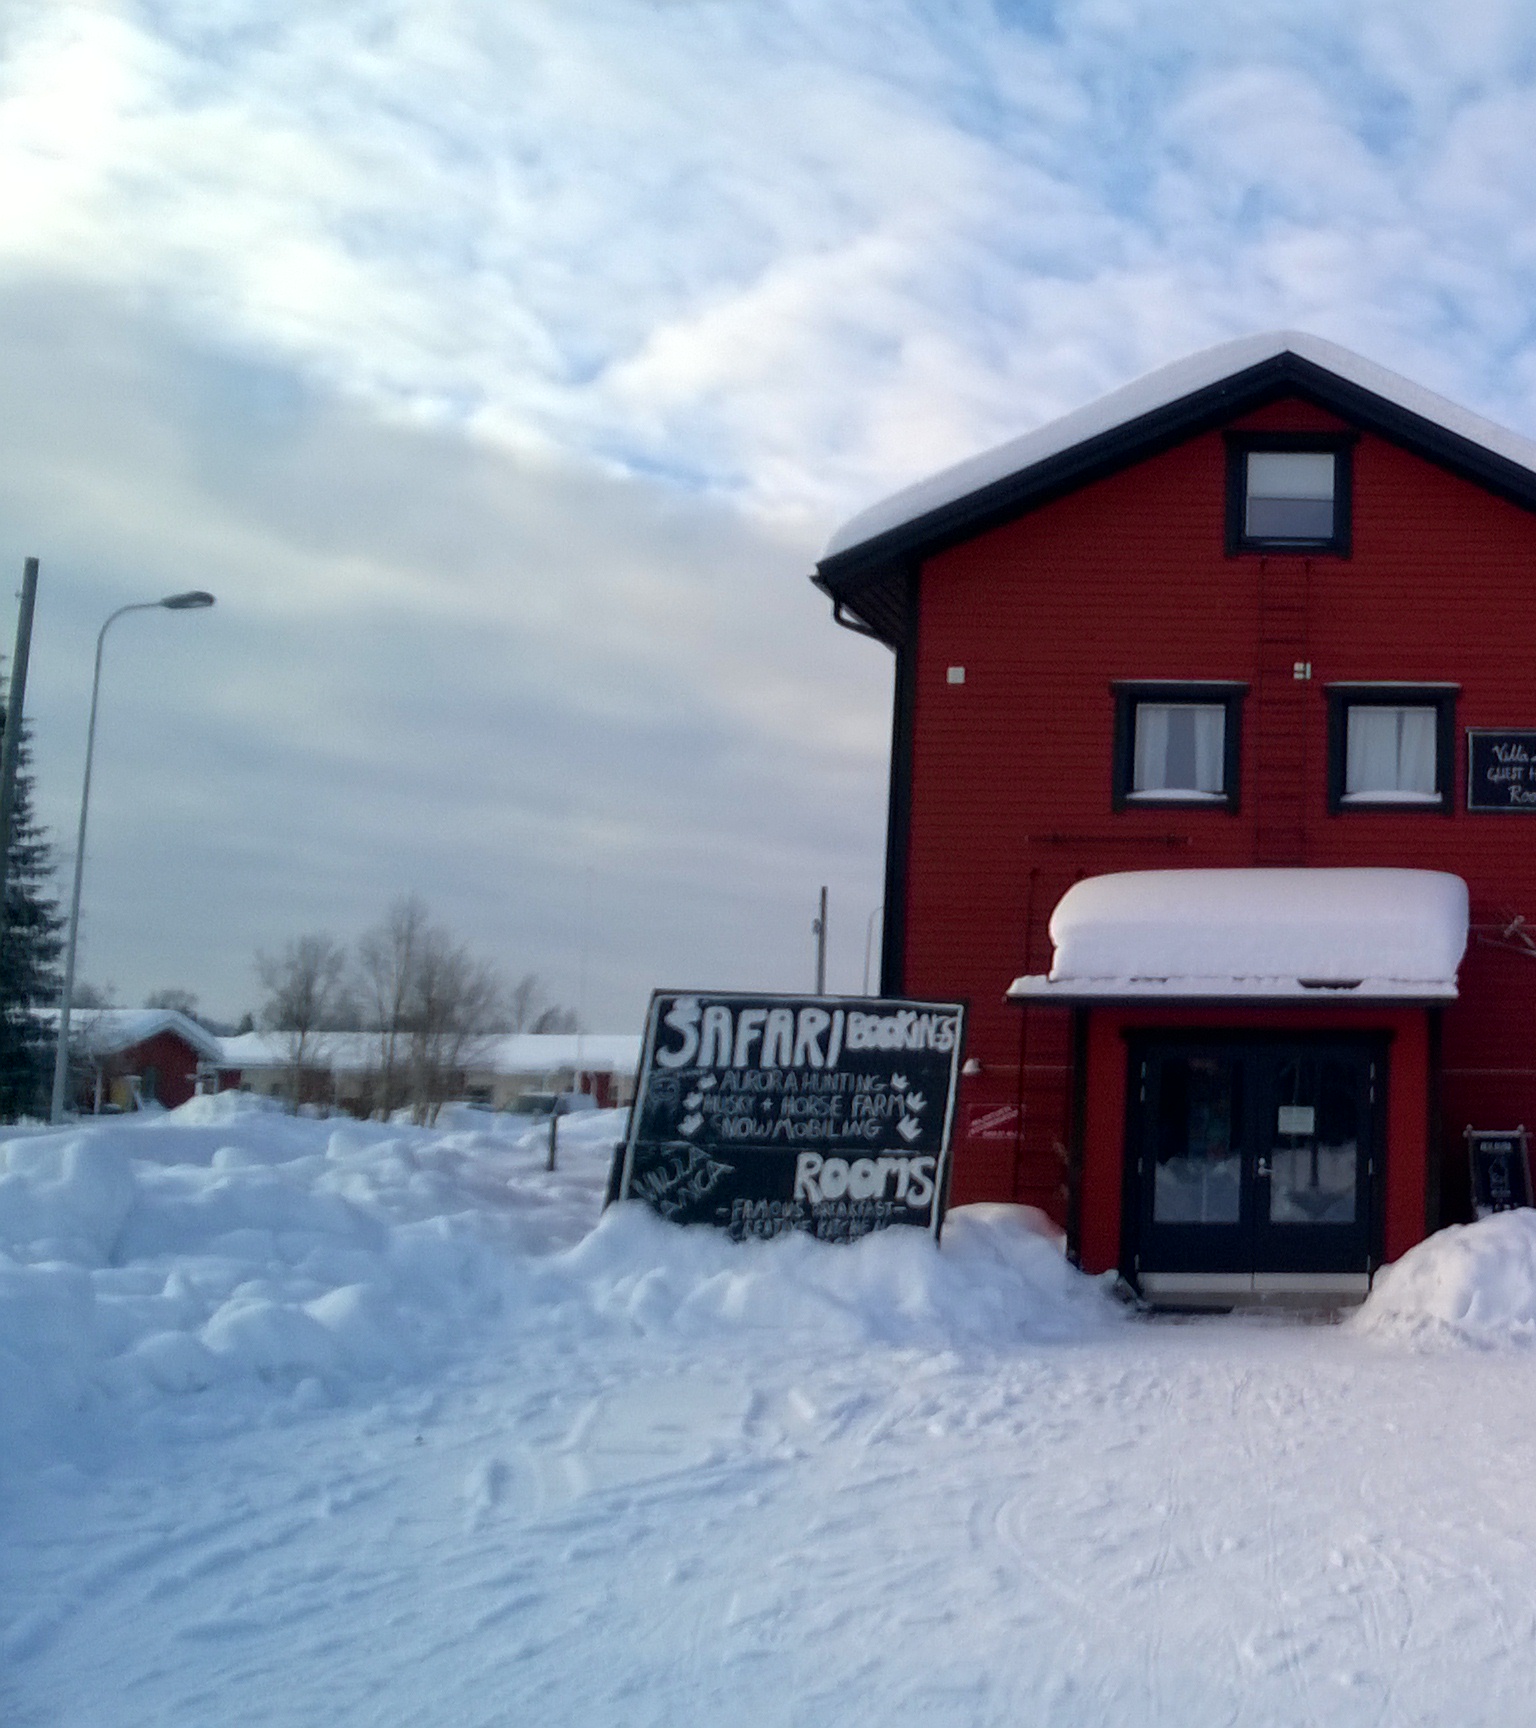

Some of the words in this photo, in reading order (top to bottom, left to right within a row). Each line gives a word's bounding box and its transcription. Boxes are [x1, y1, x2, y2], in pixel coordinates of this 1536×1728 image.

[1492, 742, 1529, 762] Villa
[1487, 766, 1525, 782] GUEST
[656, 999, 845, 1068] SAFARI
[719, 1070, 800, 1093] AURORA
[801, 1072, 888, 1092] HUNTING
[702, 1093, 757, 1116] HUSKY
[781, 1094, 842, 1118] HORSE
[851, 1094, 906, 1117] FARM
[710, 1113, 883, 1140] SNOWMOBILING
[794, 1152, 937, 1207] ROOMS
[731, 1198, 805, 1219] FAMOUS
[812, 1200, 893, 1218] BREAKFAST
